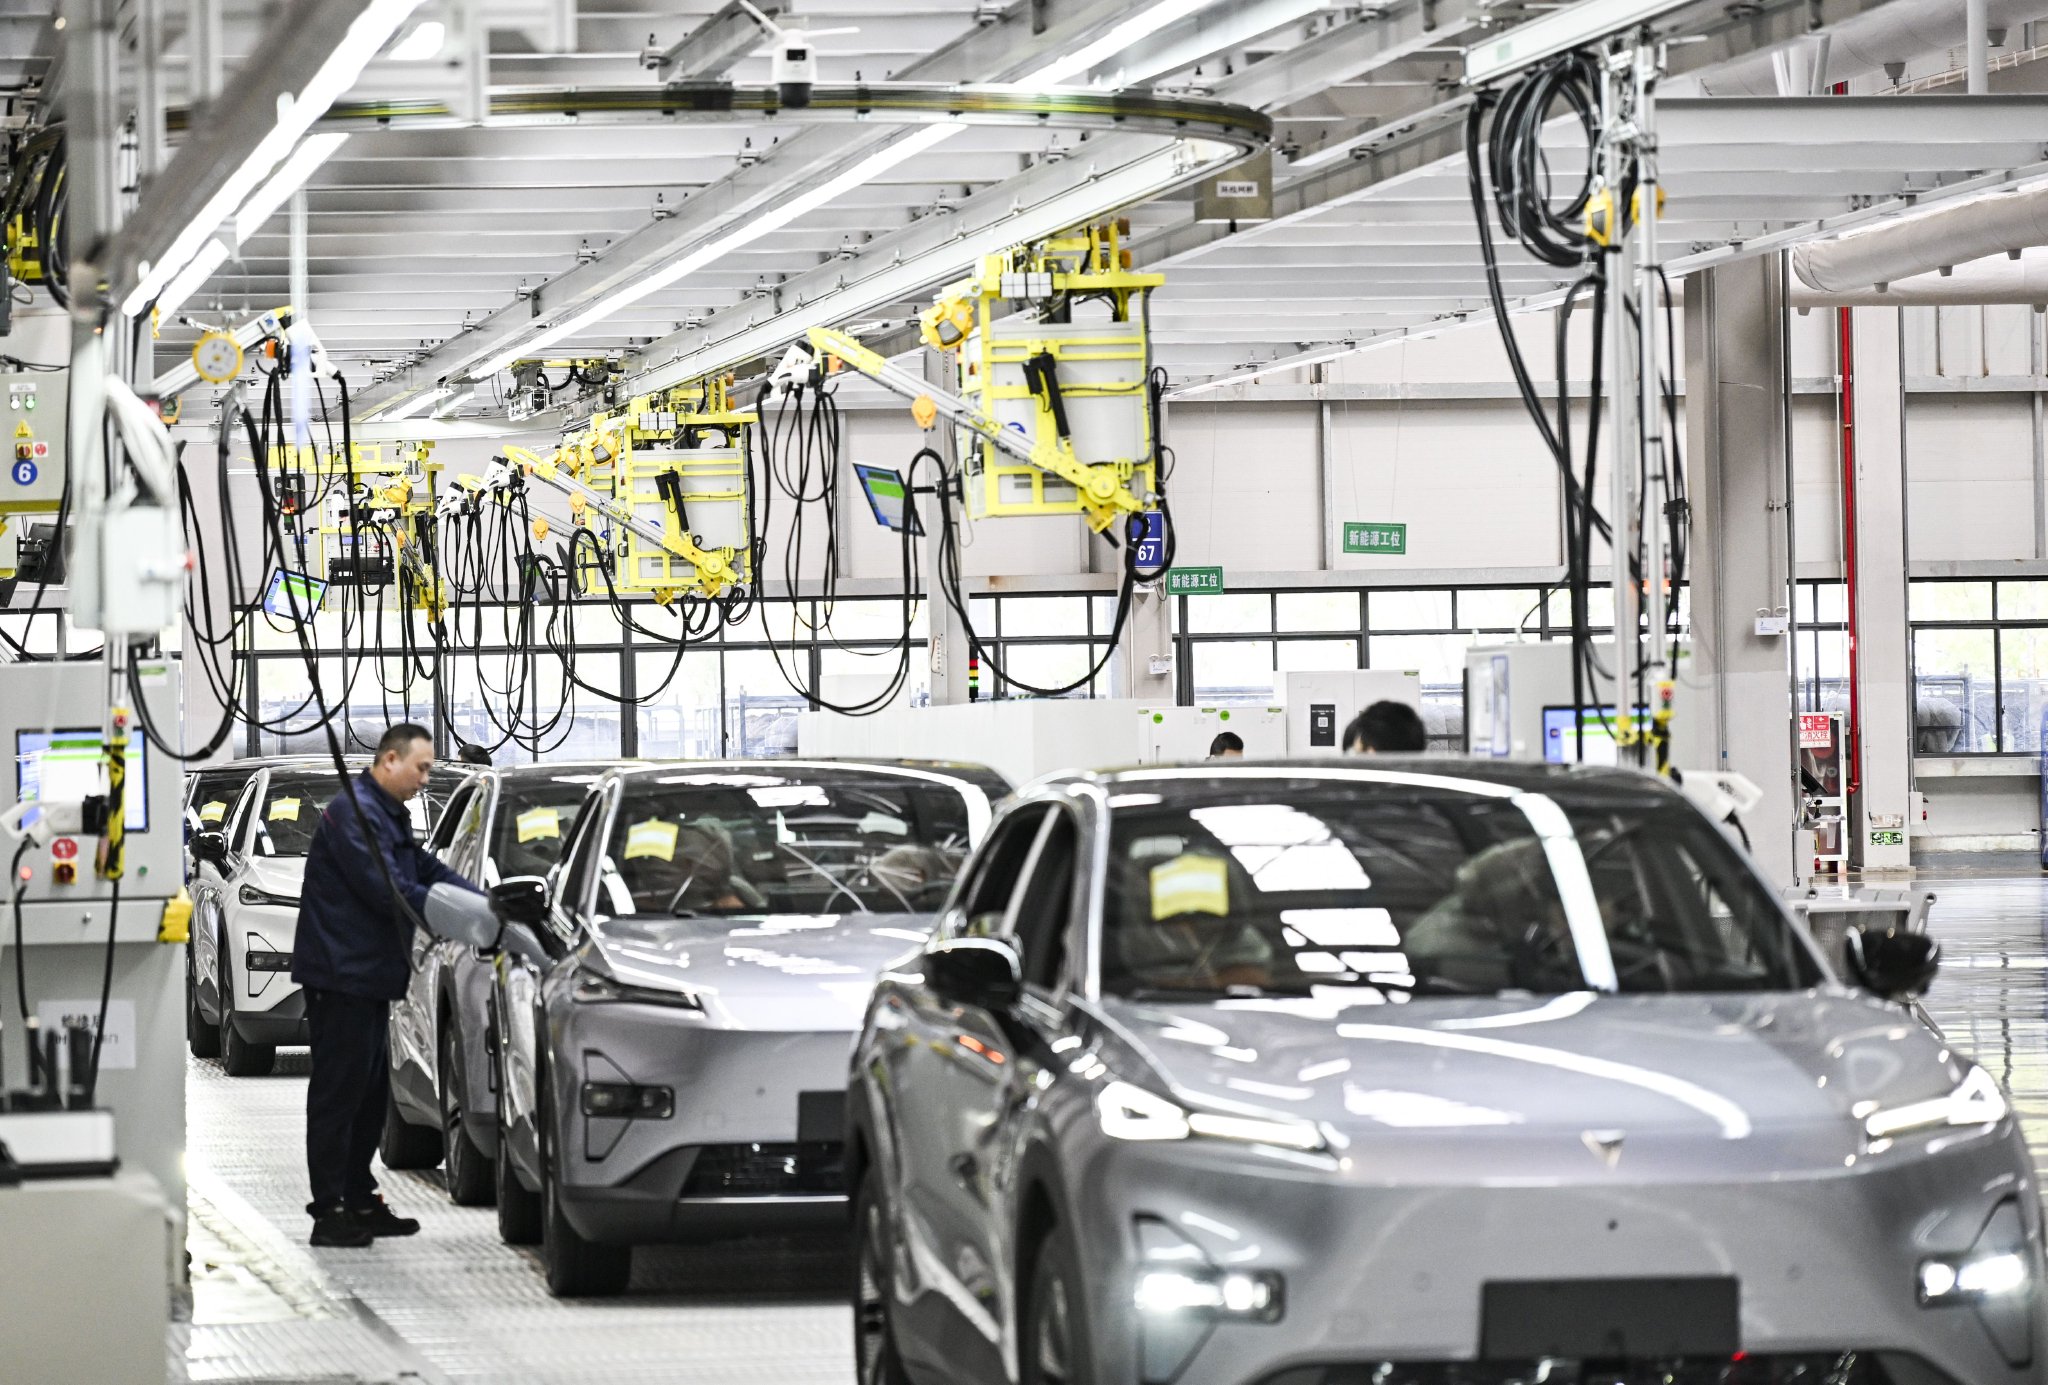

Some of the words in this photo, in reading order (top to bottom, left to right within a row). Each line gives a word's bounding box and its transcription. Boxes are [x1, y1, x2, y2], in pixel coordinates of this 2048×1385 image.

[18, 463, 31, 482] 6
[1349, 530, 1400, 546] 新能源工位
[1138, 545, 1155, 561] 67
[1172, 573, 1218, 588] 新能源工位
